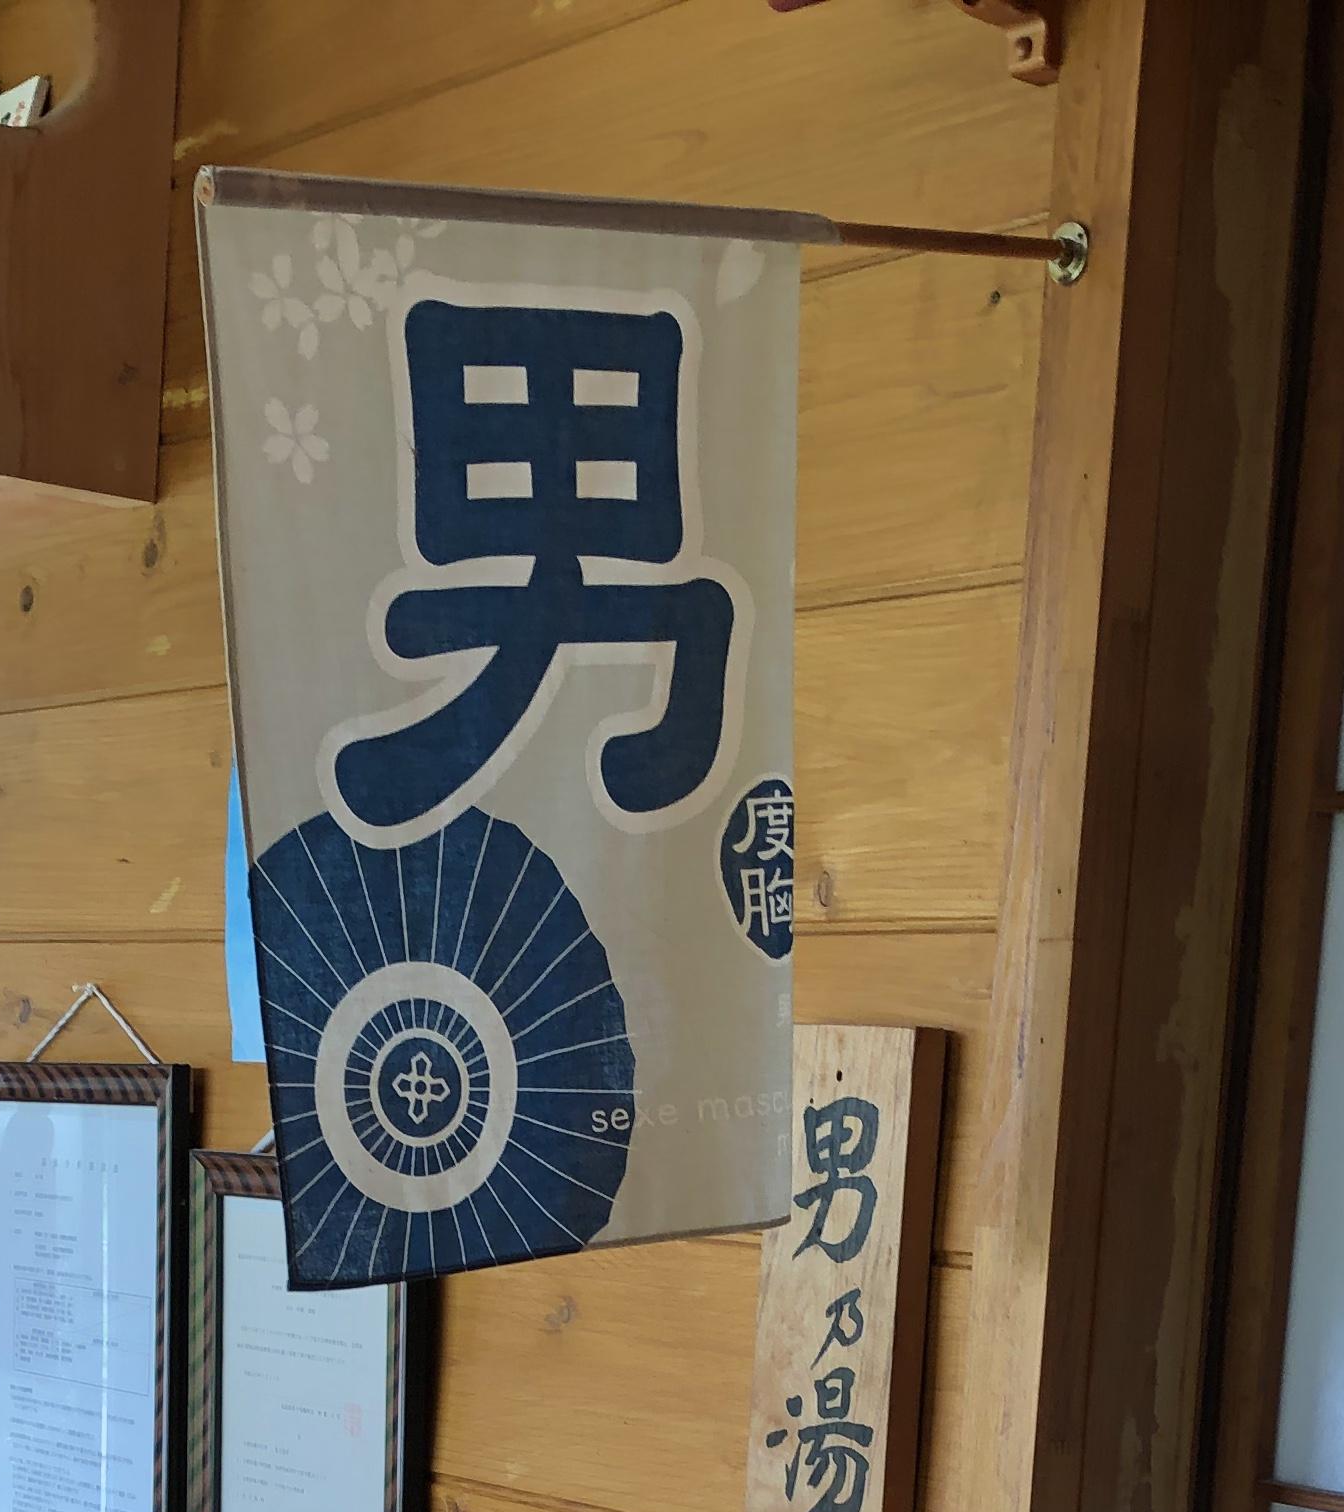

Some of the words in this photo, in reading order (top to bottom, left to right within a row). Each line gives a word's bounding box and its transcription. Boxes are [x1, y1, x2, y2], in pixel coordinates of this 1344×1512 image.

[334, 301, 734, 826] 男
[732, 789, 794, 936] 度胸
[591, 1105, 678, 1133] sexe
[698, 1091, 791, 1122] masc
